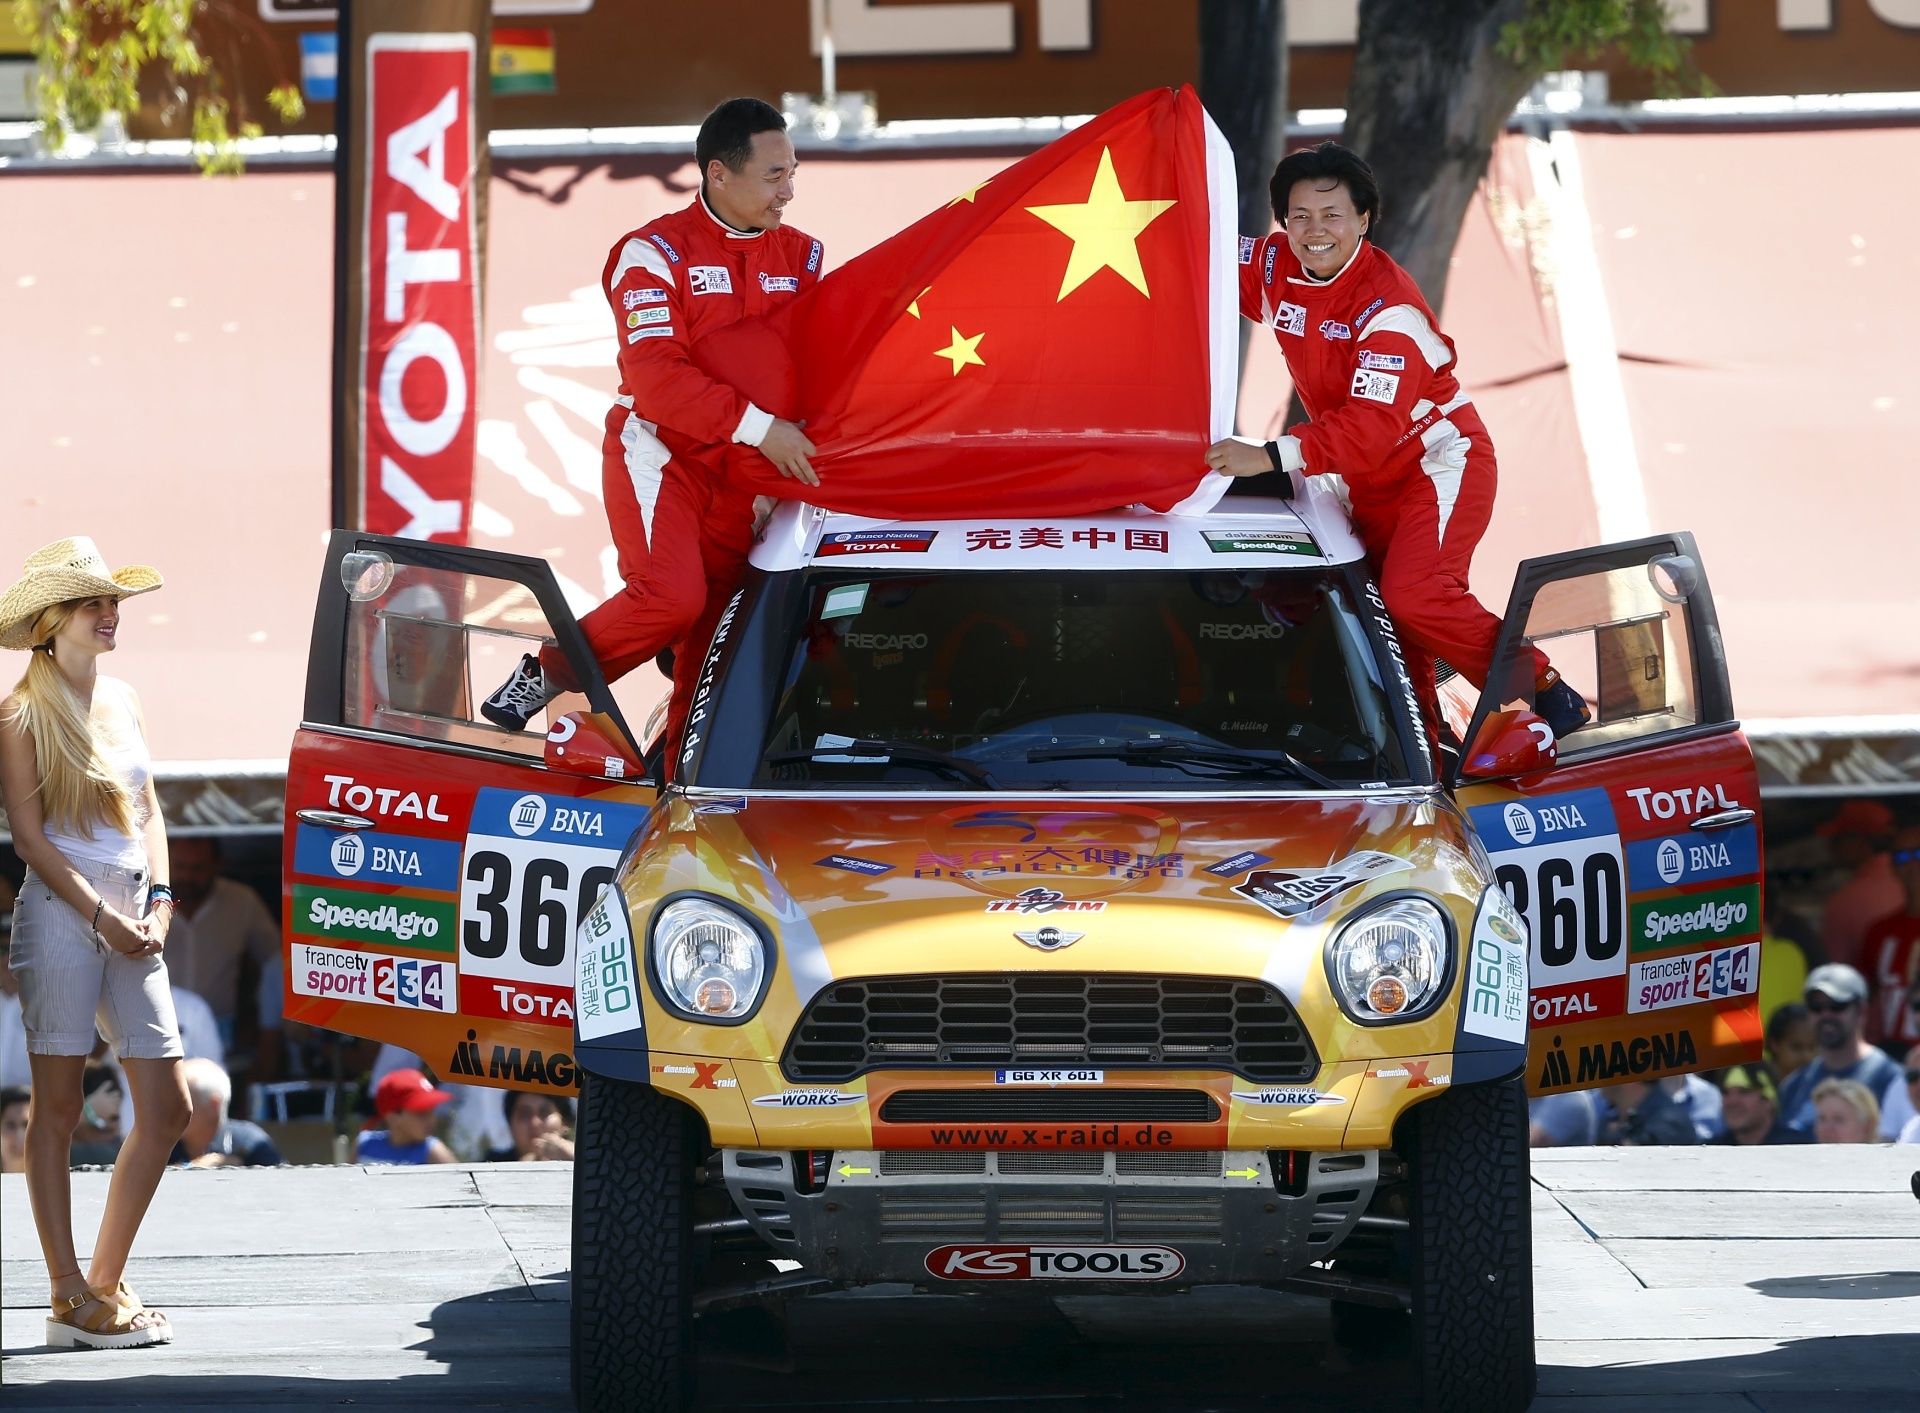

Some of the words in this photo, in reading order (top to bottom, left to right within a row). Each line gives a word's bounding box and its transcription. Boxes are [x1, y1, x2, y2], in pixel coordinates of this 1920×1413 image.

[651, 234, 679, 263] sparco
[807, 241, 820, 273] sparco
[1266, 246, 1276, 284] sparco
[708, 282, 730, 291] PERFECT
[640, 309, 667, 319] 360
[1355, 299, 1384, 329] sparco
[1367, 388, 1394, 400] PERFECT
[843, 543, 902, 551] TOTAL
[965, 526, 1169, 554] 完美中国
[1224, 531, 1294, 540] dakar.com
[1232, 542, 1298, 551] SpeedAgro
[844, 632, 929, 650] RECARO
[1199, 622, 1285, 640] RECARO
[682, 588, 745, 764] www.x-raid.de
[1365, 583, 1431, 753] www.x-raid.de
[323, 774, 450, 823] TOTAL
[1625, 783, 1739, 821] TOTAL
[550, 808, 604, 837] BNA
[1537, 804, 1587, 833] BNA
[370, 847, 423, 877] BNA
[1688, 842, 1732, 872] BNA
[1281, 874, 1347, 899] 360
[308, 897, 439, 941] SpeedAgro
[1644, 901, 1748, 942] SpeedAgro
[1038, 933, 1061, 941] MINI
[306, 970, 367, 996] sport
[601, 937, 632, 1014] 360
[1472, 939, 1502, 1018] 360
[1639, 974, 1690, 1009] sport
[1577, 1029, 1698, 1083] MAGNA
[1012, 1071, 1035, 1081] GG
[1039, 1071, 1062, 1081] XR
[1067, 1071, 1098, 1081] 601
[782, 1094, 838, 1105] WORKS
[1260, 1093, 1317, 1104] WORKS
[930, 1124, 1174, 1146] www.x-raid.de
[943, 1250, 1028, 1274] KS
[1025, 1252, 1164, 1273] TOOLS
